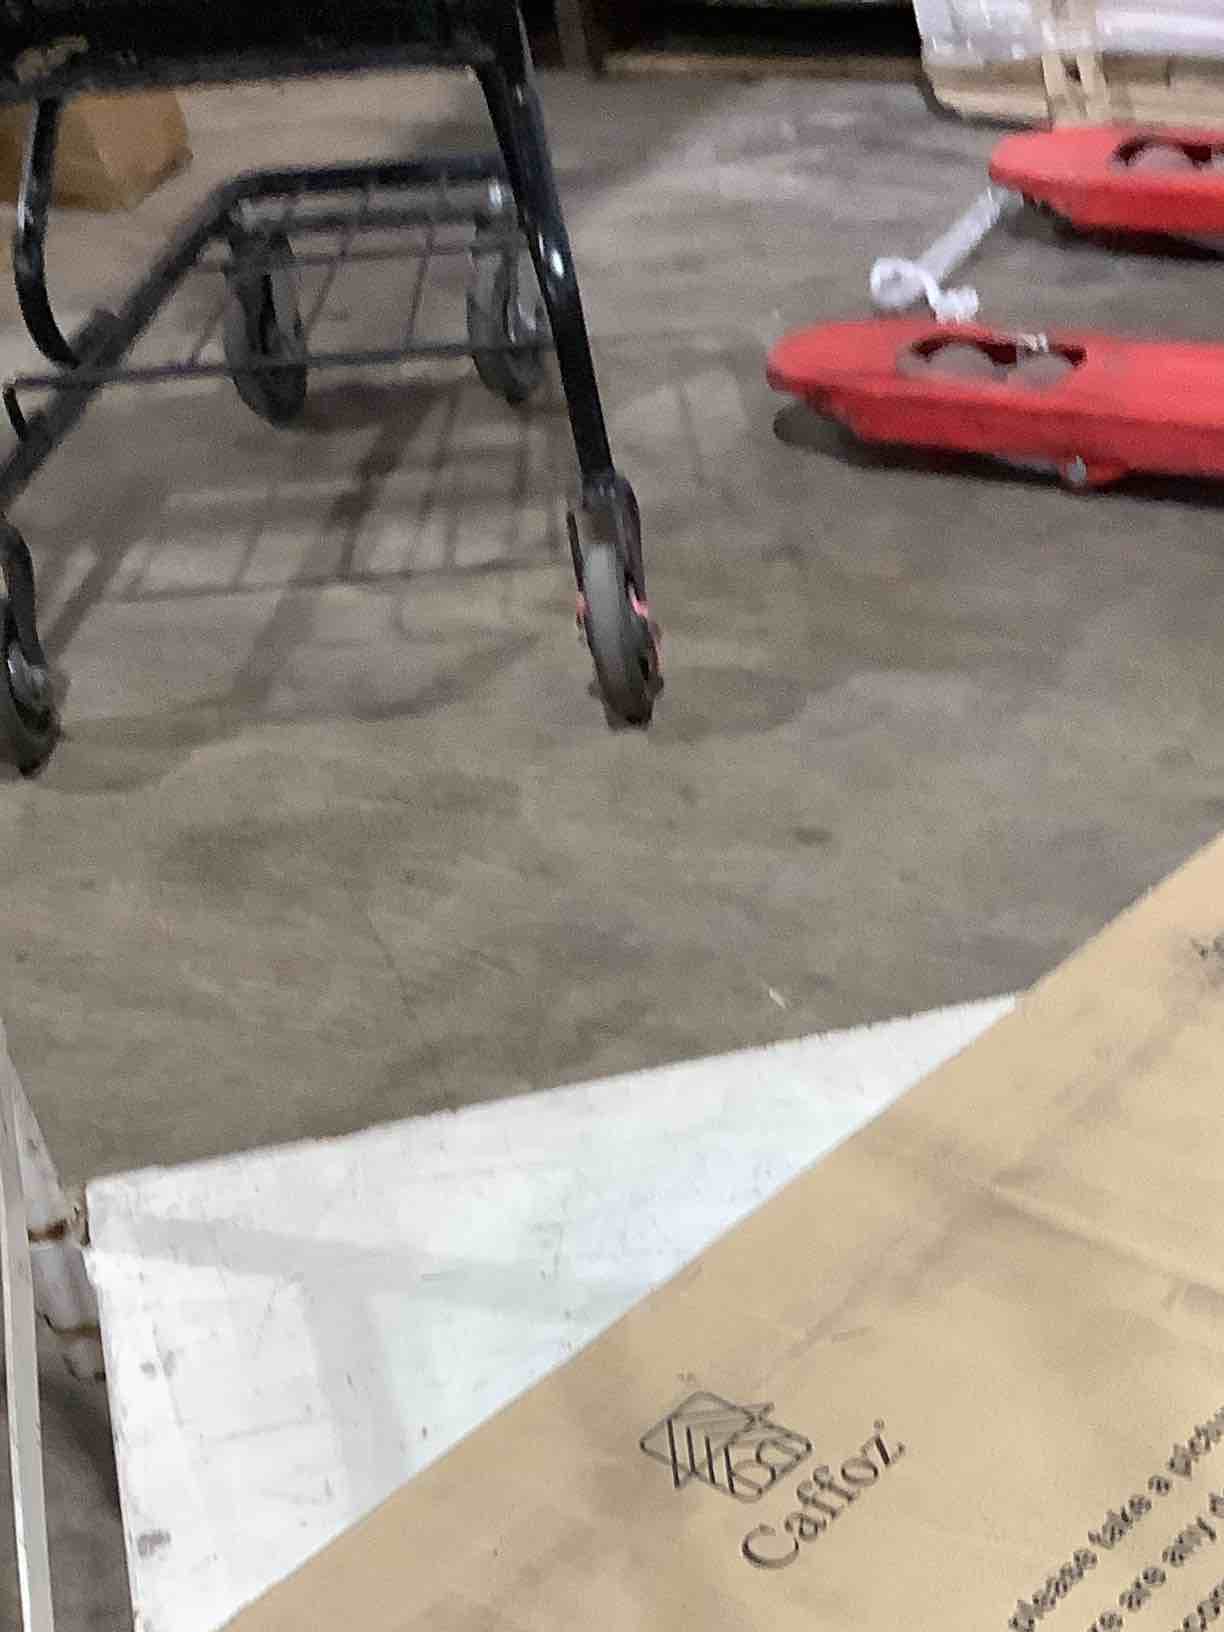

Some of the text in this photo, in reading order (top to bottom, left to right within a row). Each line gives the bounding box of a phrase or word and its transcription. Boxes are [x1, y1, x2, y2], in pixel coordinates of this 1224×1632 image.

[1087, 1495, 1153, 1550] take
[1147, 1475, 1172, 1496] a
[1118, 1566, 1167, 1612] are
[1161, 1516, 1217, 1568] any
